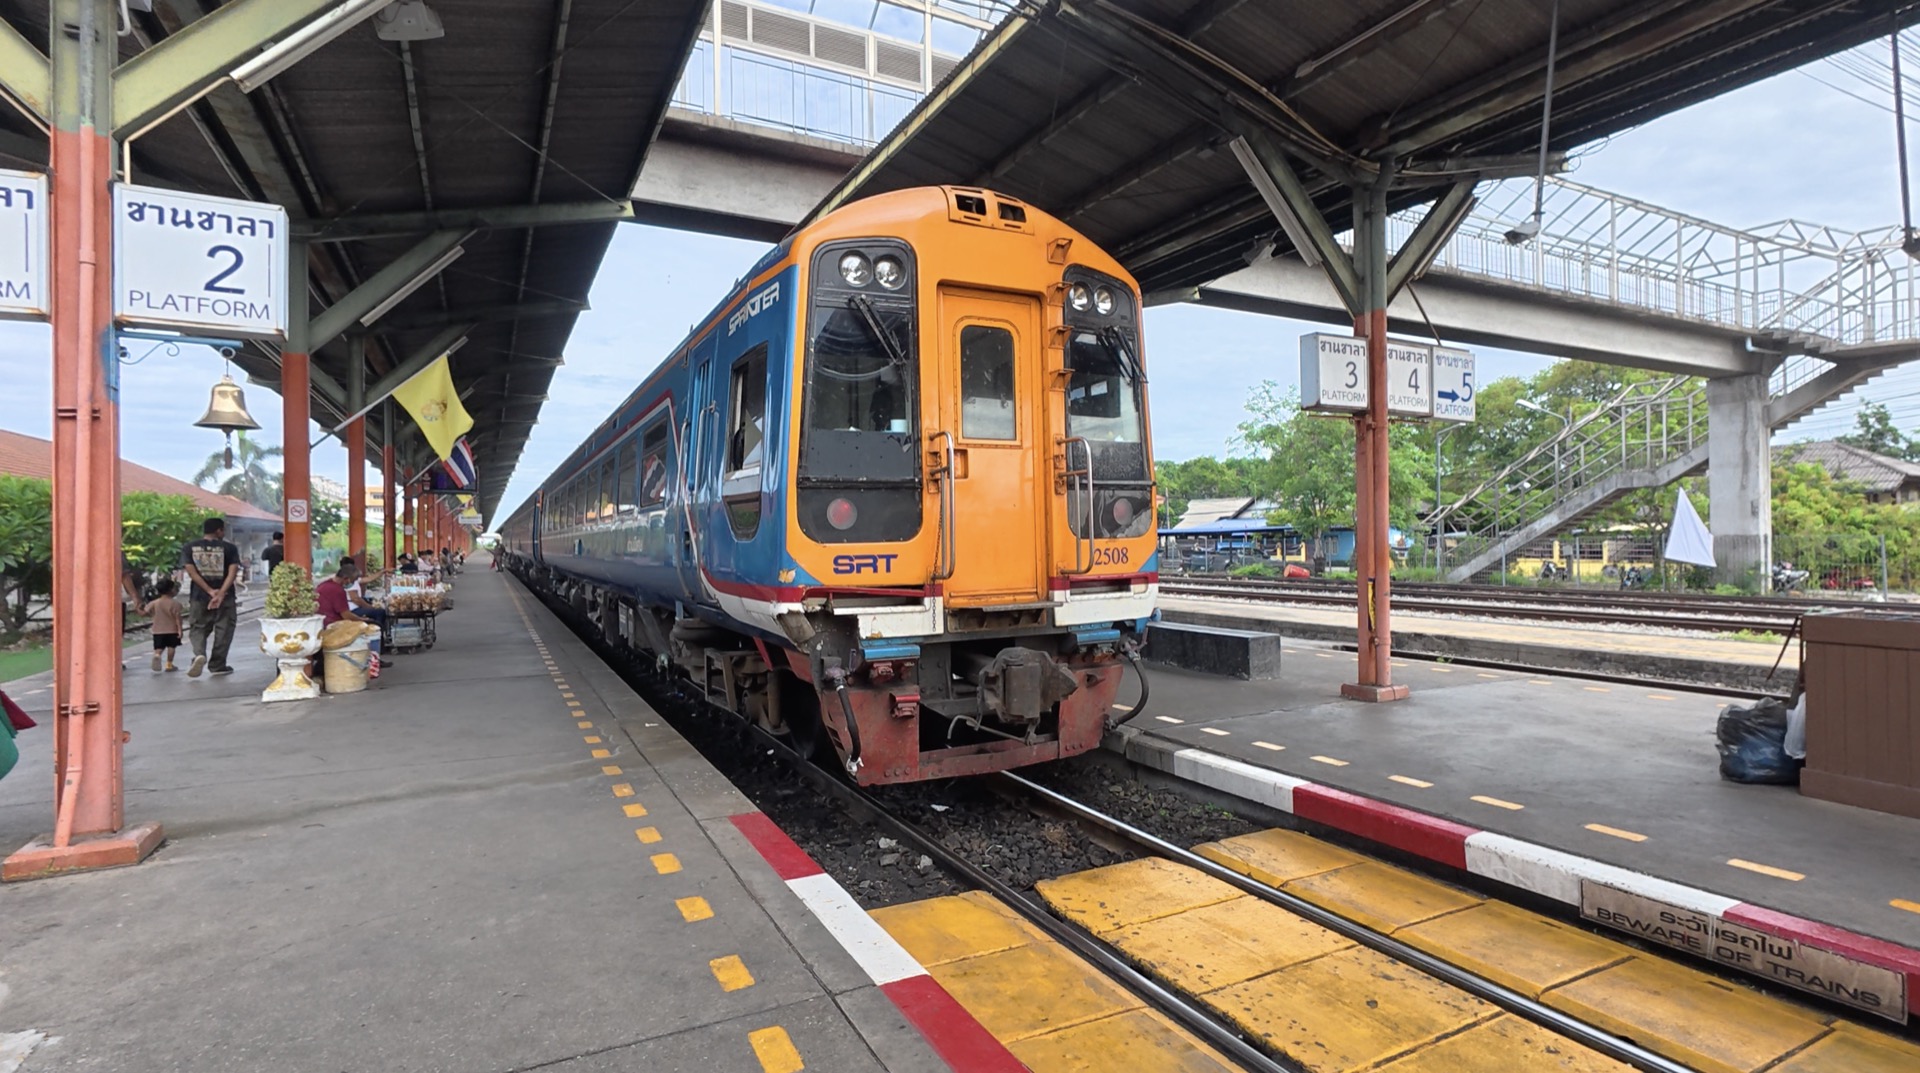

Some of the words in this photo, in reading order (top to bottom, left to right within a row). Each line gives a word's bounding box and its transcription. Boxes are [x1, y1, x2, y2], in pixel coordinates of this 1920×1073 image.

[127, 201, 275, 239] ชานชาลา
[203, 244, 246, 296] 2
[128, 290, 271, 321] PLATFORM
[1320, 340, 1366, 356] ชานชาลา
[1388, 348, 1428, 363] ชานชาลา
[1436, 355, 1474, 369] ชานชาลา
[1345, 361, 1358, 389] 3
[1408, 368, 1420, 394] 4
[1322, 389, 1365, 402] PLATFORM
[1460, 372, 1473, 402] 5
[1389, 395, 1428, 407] PLATFORM
[1436, 403, 1473, 416] PLATFORM
[833, 554, 898, 575] SRT
[1094, 547, 1129, 566] 2508
[1596, 907, 1702, 949] BEWARE
[1716, 945, 1752, 963] OF
[1766, 960, 1881, 1008] TRAINS
